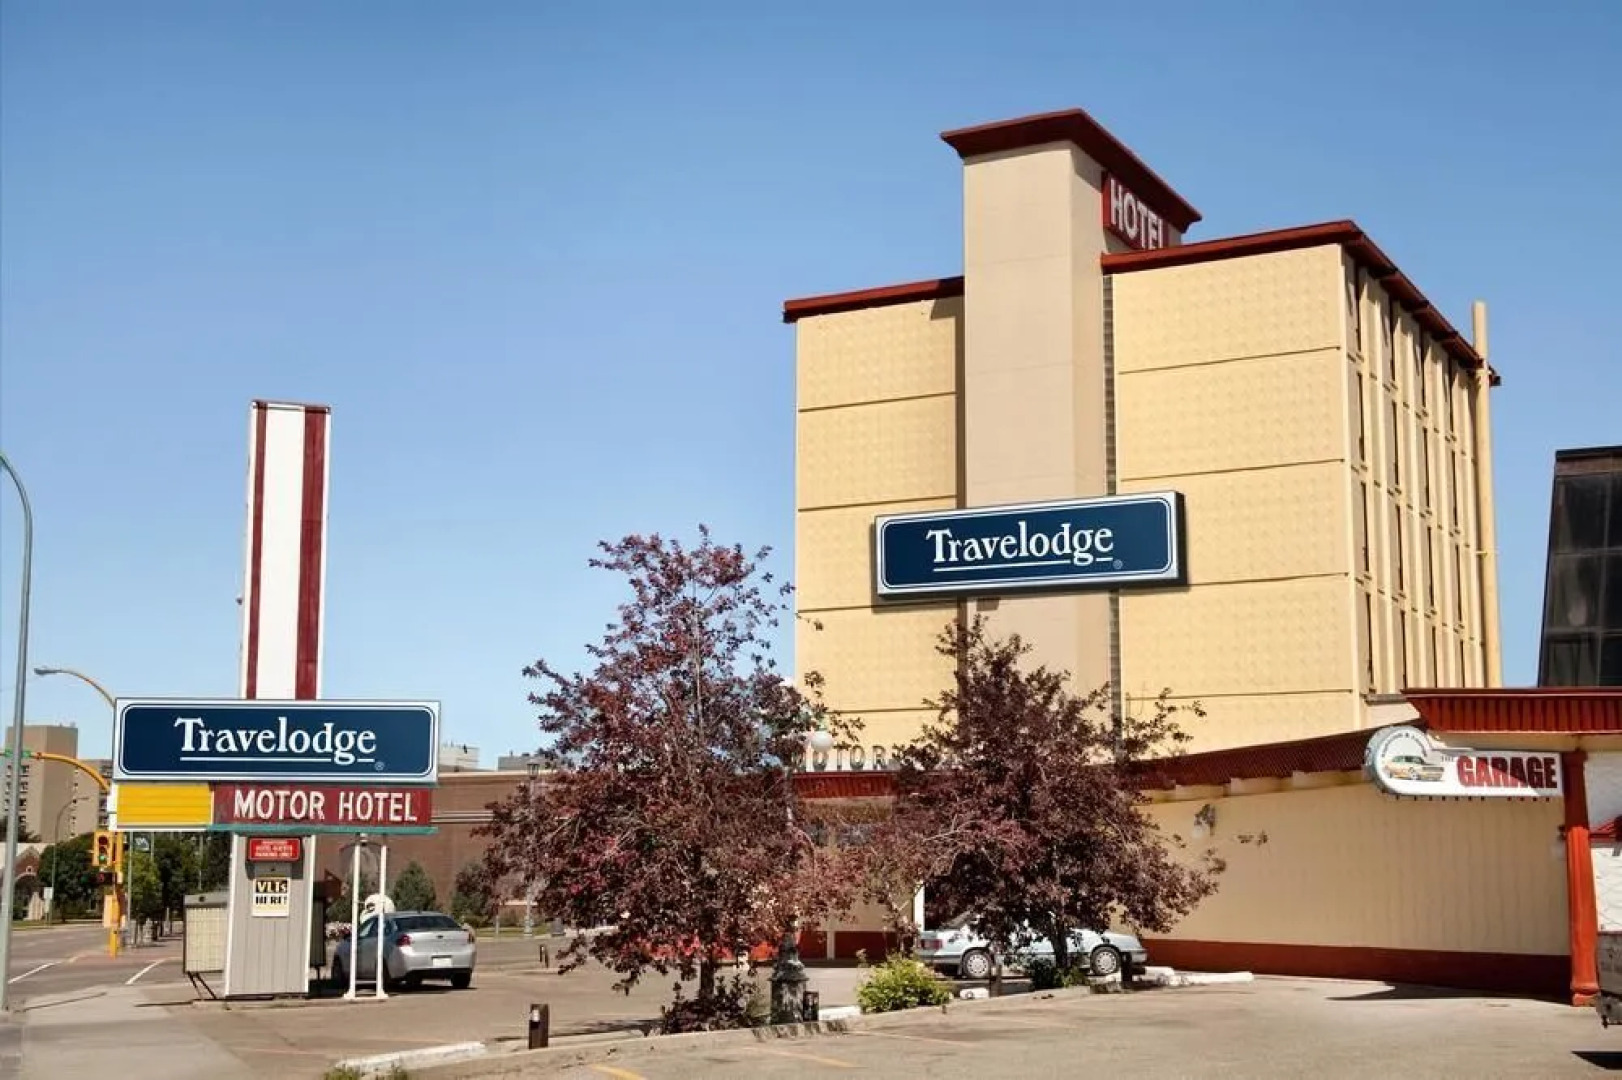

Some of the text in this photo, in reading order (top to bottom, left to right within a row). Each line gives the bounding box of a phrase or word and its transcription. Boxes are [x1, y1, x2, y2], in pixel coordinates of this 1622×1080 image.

[1110, 178, 1164, 251] HOTEL
[926, 520, 1114, 567] Travelodge
[174, 716, 377, 766] Travelodge
[1456, 755, 1558, 789] GARAGE
[233, 788, 418, 823] MOTOR HOTEL
